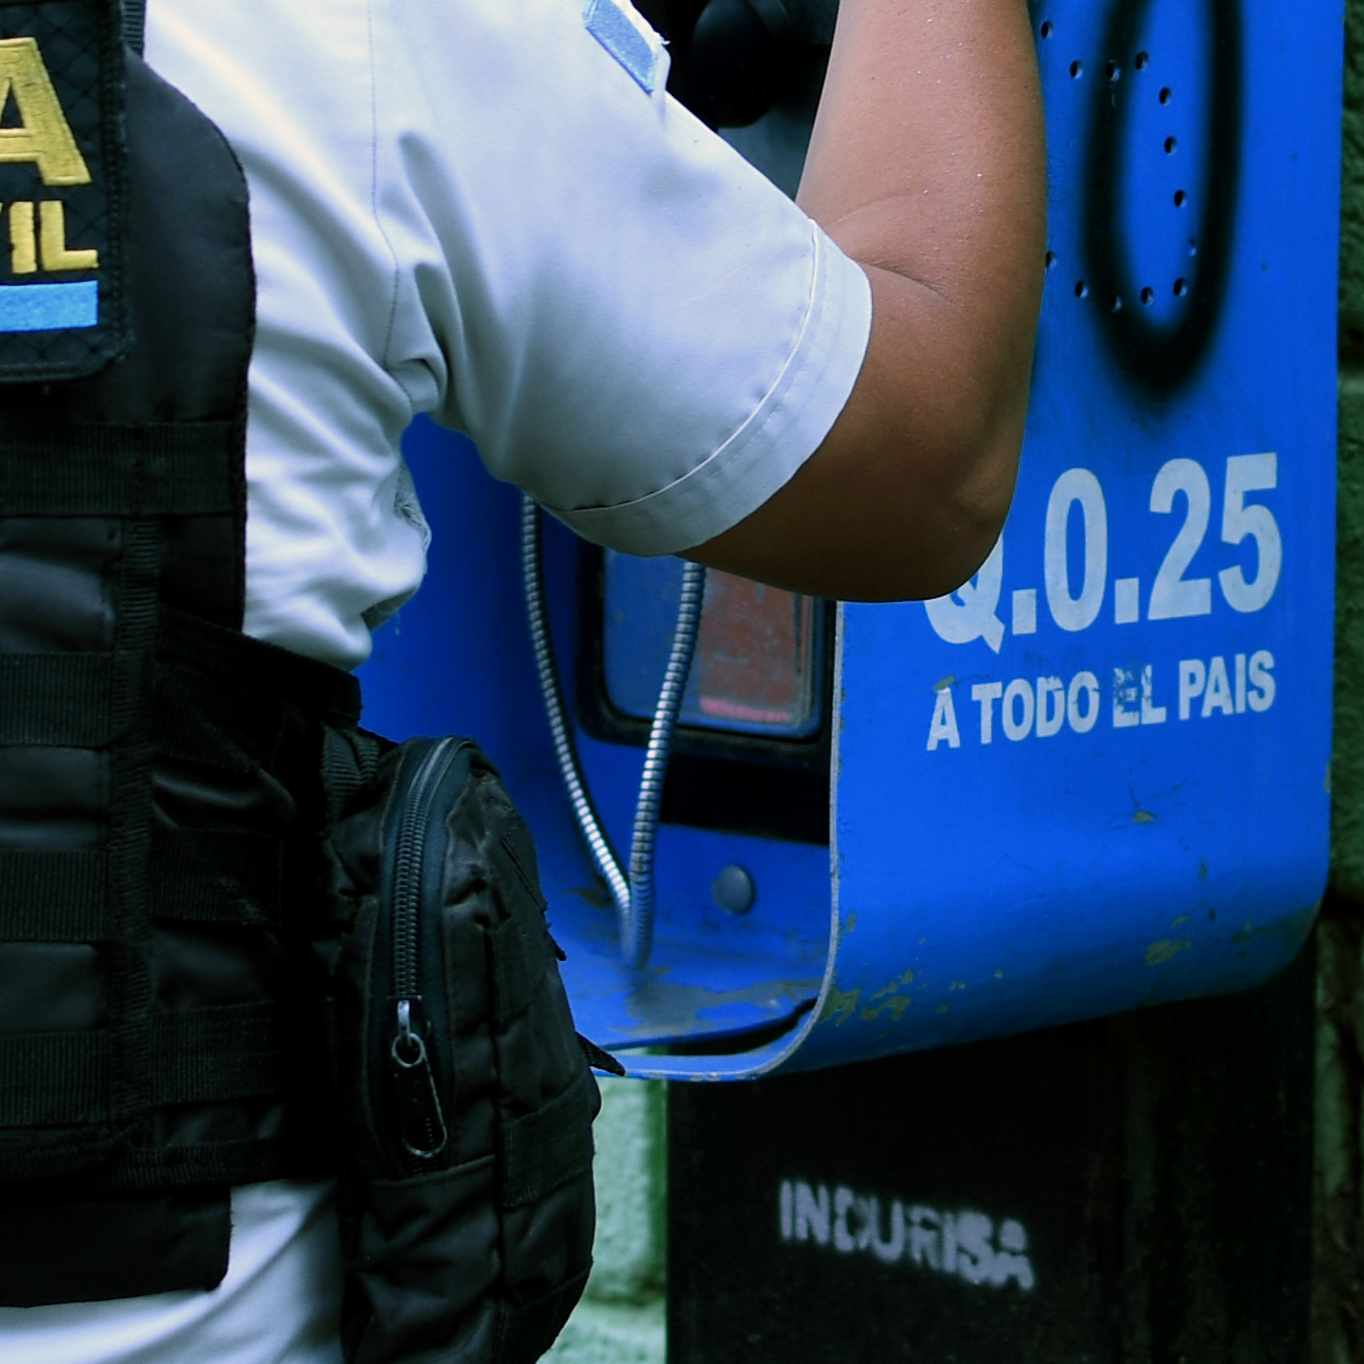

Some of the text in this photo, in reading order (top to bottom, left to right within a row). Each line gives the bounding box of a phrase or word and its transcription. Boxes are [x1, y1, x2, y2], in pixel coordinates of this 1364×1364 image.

[926, 650, 1276, 751] A TODO EL PAIS
